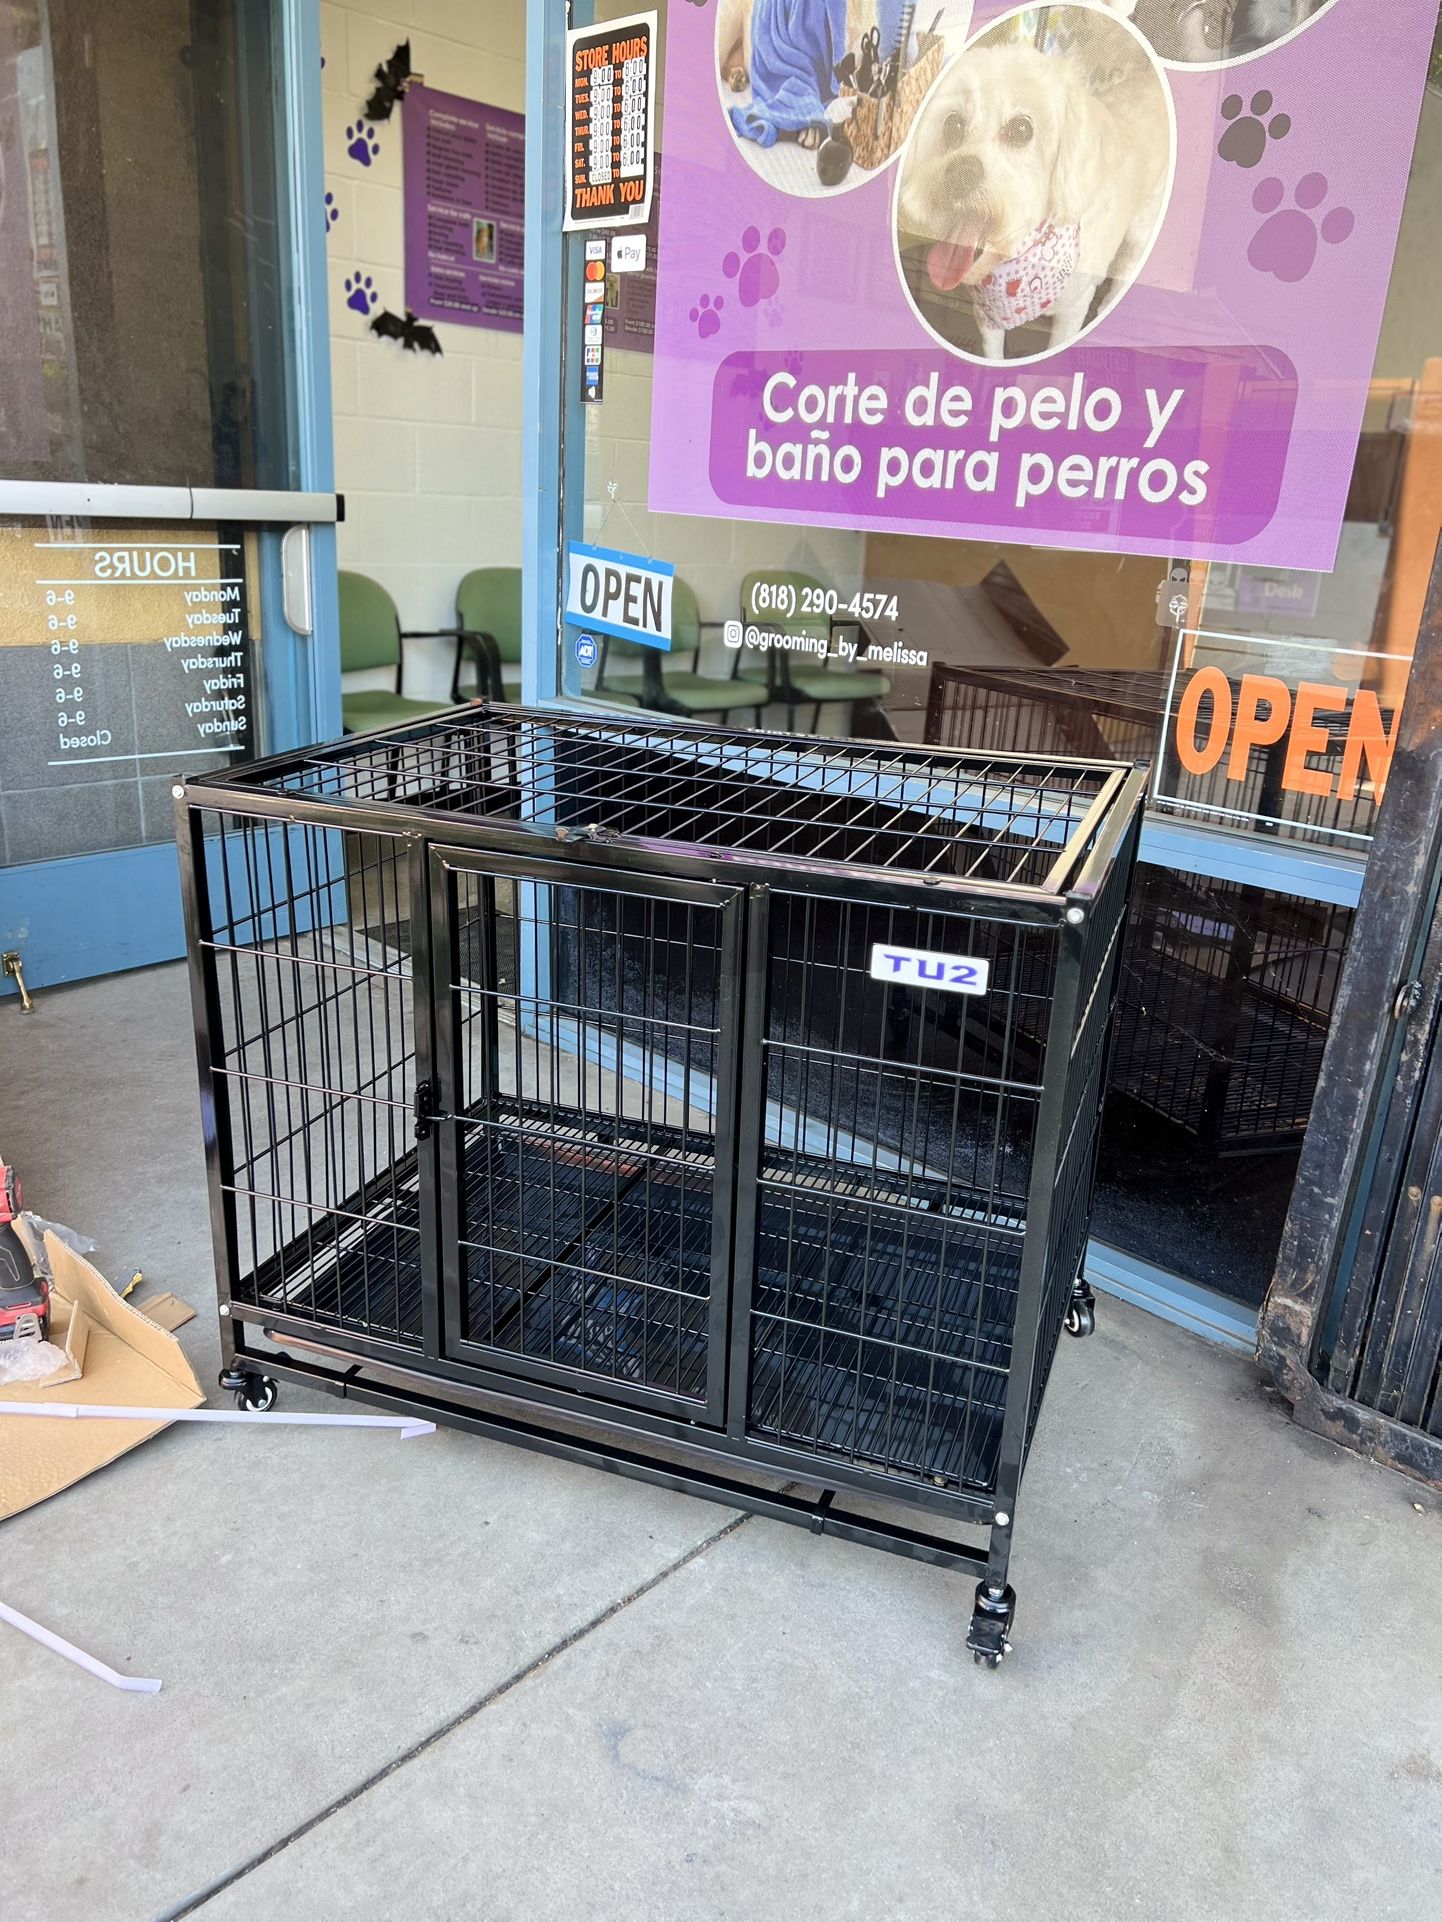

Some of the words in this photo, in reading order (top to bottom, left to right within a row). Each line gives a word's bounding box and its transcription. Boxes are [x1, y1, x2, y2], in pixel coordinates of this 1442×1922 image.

[575, 44, 609, 72] STORE
[612, 36, 648, 64] HOURS
[614, 69, 622, 79] TO
[614, 85, 621, 96] TO
[613, 102, 621, 112] TO
[613, 119, 621, 129] TO
[612, 135, 620, 146] TO
[612, 151, 620, 162] TO
[591, 170, 611, 183] CLOSED
[612, 167, 620, 178] TO
[575, 184, 615, 208] THANK
[619, 180, 644, 202] YOU
[588, 245, 602, 254] VISA
[624, 246, 641, 262] Pay
[762, 371, 889, 428] Corte
[903, 371, 972, 428] de
[989, 372, 1122, 443] pelo
[1143, 386, 1186, 448] y
[745, 428, 862, 485] baño
[876, 444, 999, 499] para
[1015, 451, 1210, 507] perros
[580, 562, 663, 633] OPEN
[751, 581, 797, 618] (818)
[801, 589, 899, 622] 290-4574
[745, 625, 928, 667] @grooming_by_melissa
[1175, 665, 1402, 807] OPEN
[883, 953, 978, 986] TU2
